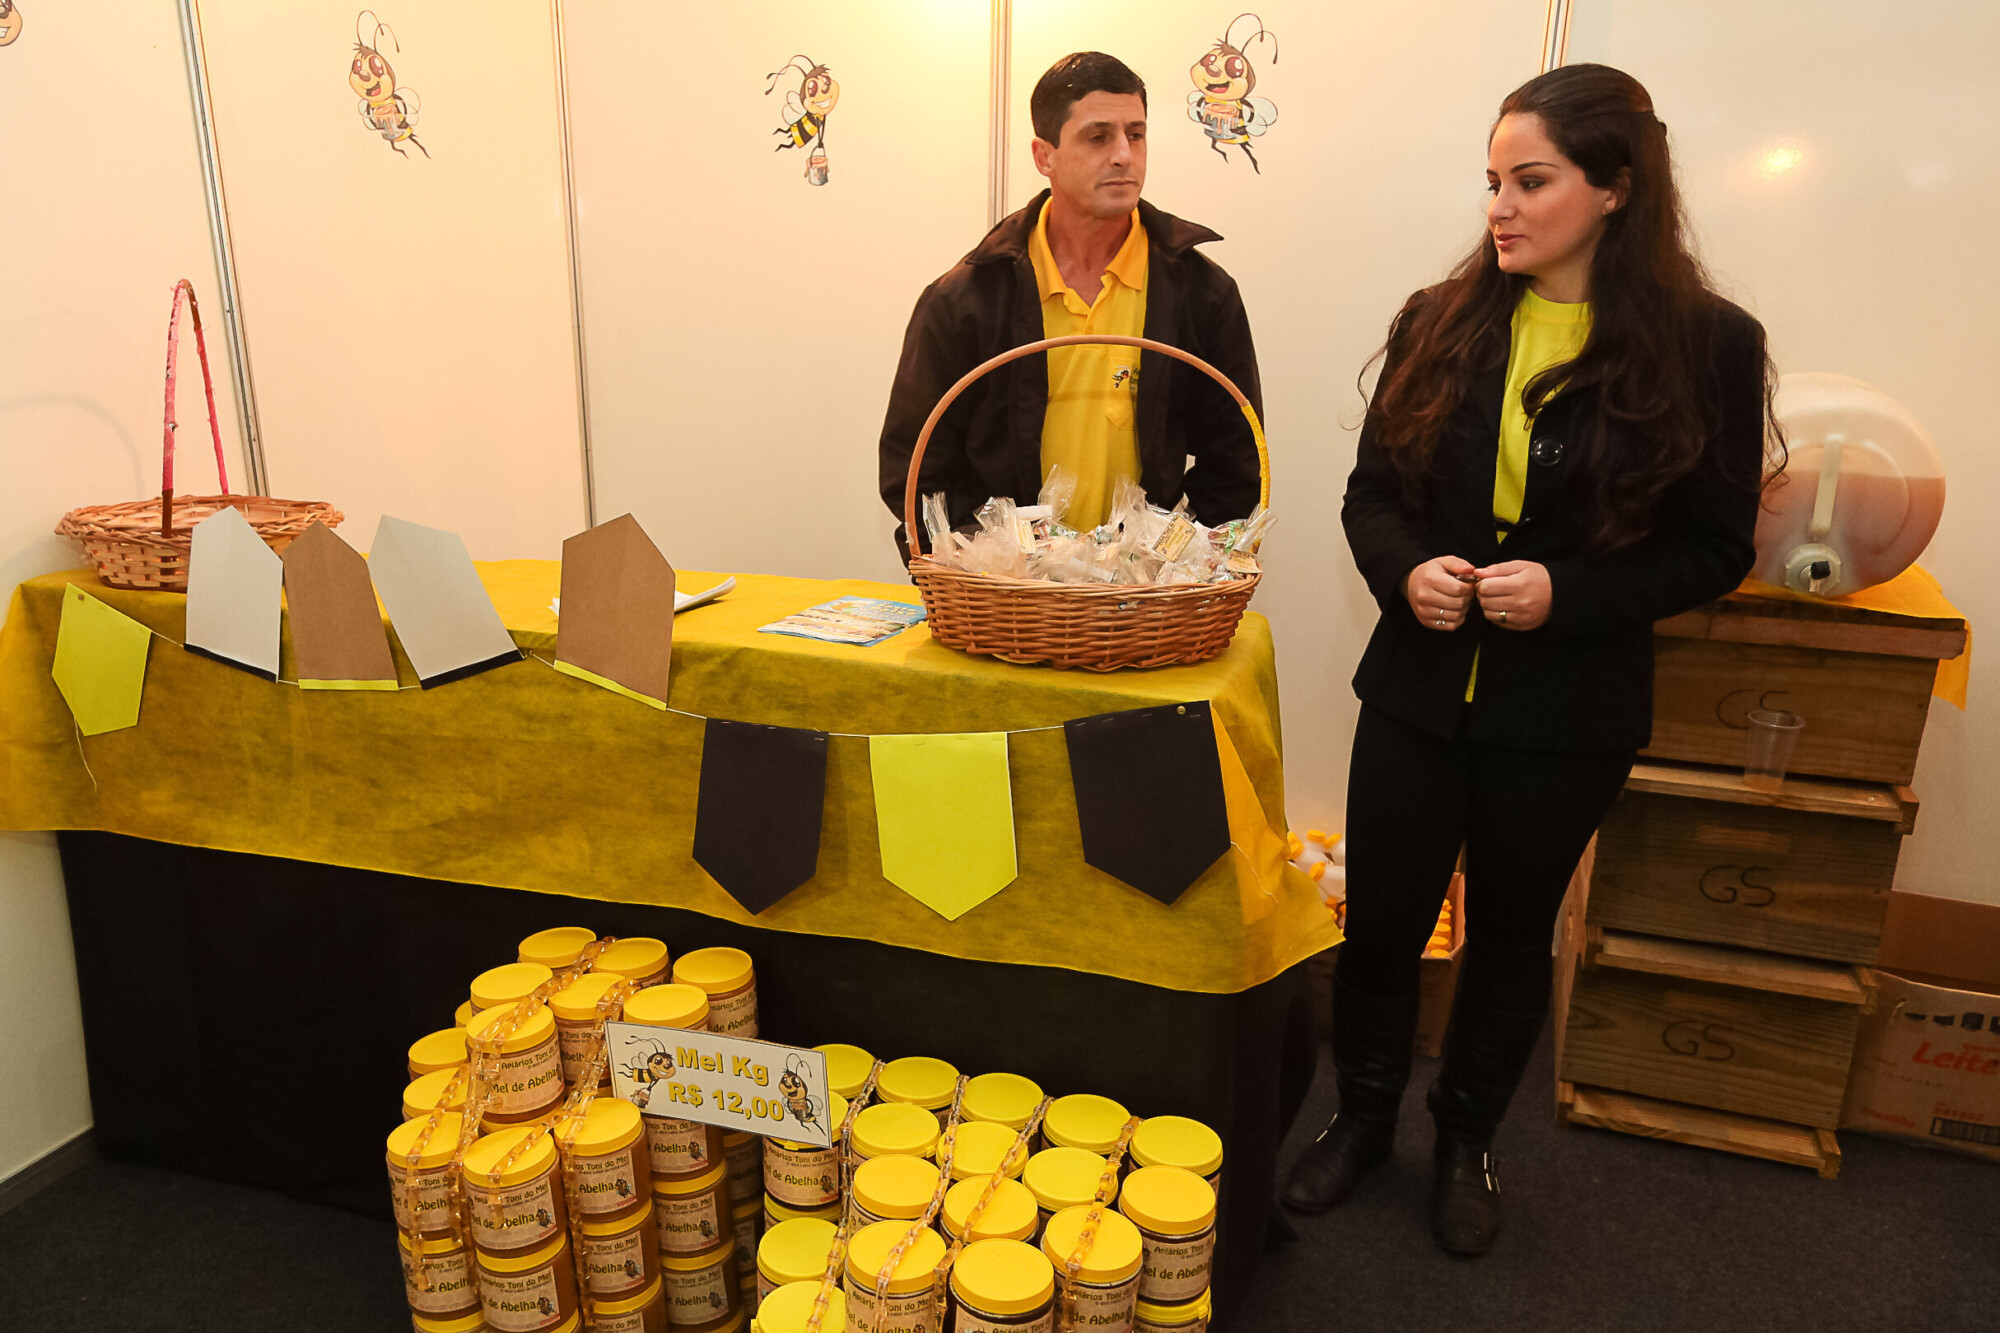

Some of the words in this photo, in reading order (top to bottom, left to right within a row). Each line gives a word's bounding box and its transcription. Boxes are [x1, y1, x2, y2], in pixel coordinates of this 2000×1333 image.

[1700, 865, 1776, 907] GS
[1663, 1020, 1736, 1061] GS
[501, 1054, 534, 1070] Apiários
[1911, 1041, 2000, 1076] Leite
[675, 1046, 723, 1074] Mel
[731, 1055, 769, 1087] Kg
[511, 1082, 525, 1093] de
[528, 1069, 557, 1090] Abelha
[667, 1080, 704, 1108] R$
[711, 1088, 785, 1122] 12,00
[653, 1143, 687, 1153] Abelha
[586, 1163, 603, 1171] Toni
[604, 1160, 615, 1168] do
[773, 1169, 782, 1180] de
[784, 1174, 819, 1186] Abelha
[579, 1182, 614, 1194] Abelha
[504, 1194, 522, 1203] Toni
[524, 1190, 534, 1198] do
[414, 1197, 448, 1212] Abelh
[483, 1218, 494, 1229] de
[500, 1213, 535, 1229] belha
[665, 1223, 698, 1233] Abelha
[589, 1263, 623, 1274] Abelha
[1159, 1269, 1174, 1280] de
[439, 1278, 469, 1292] Abelh
[501, 1300, 536, 1312] Abelha
[675, 1295, 708, 1306] Abelha
[904, 1302, 915, 1311] do
[1089, 1311, 1125, 1325] Abelha
[857, 1319, 868, 1332] de
